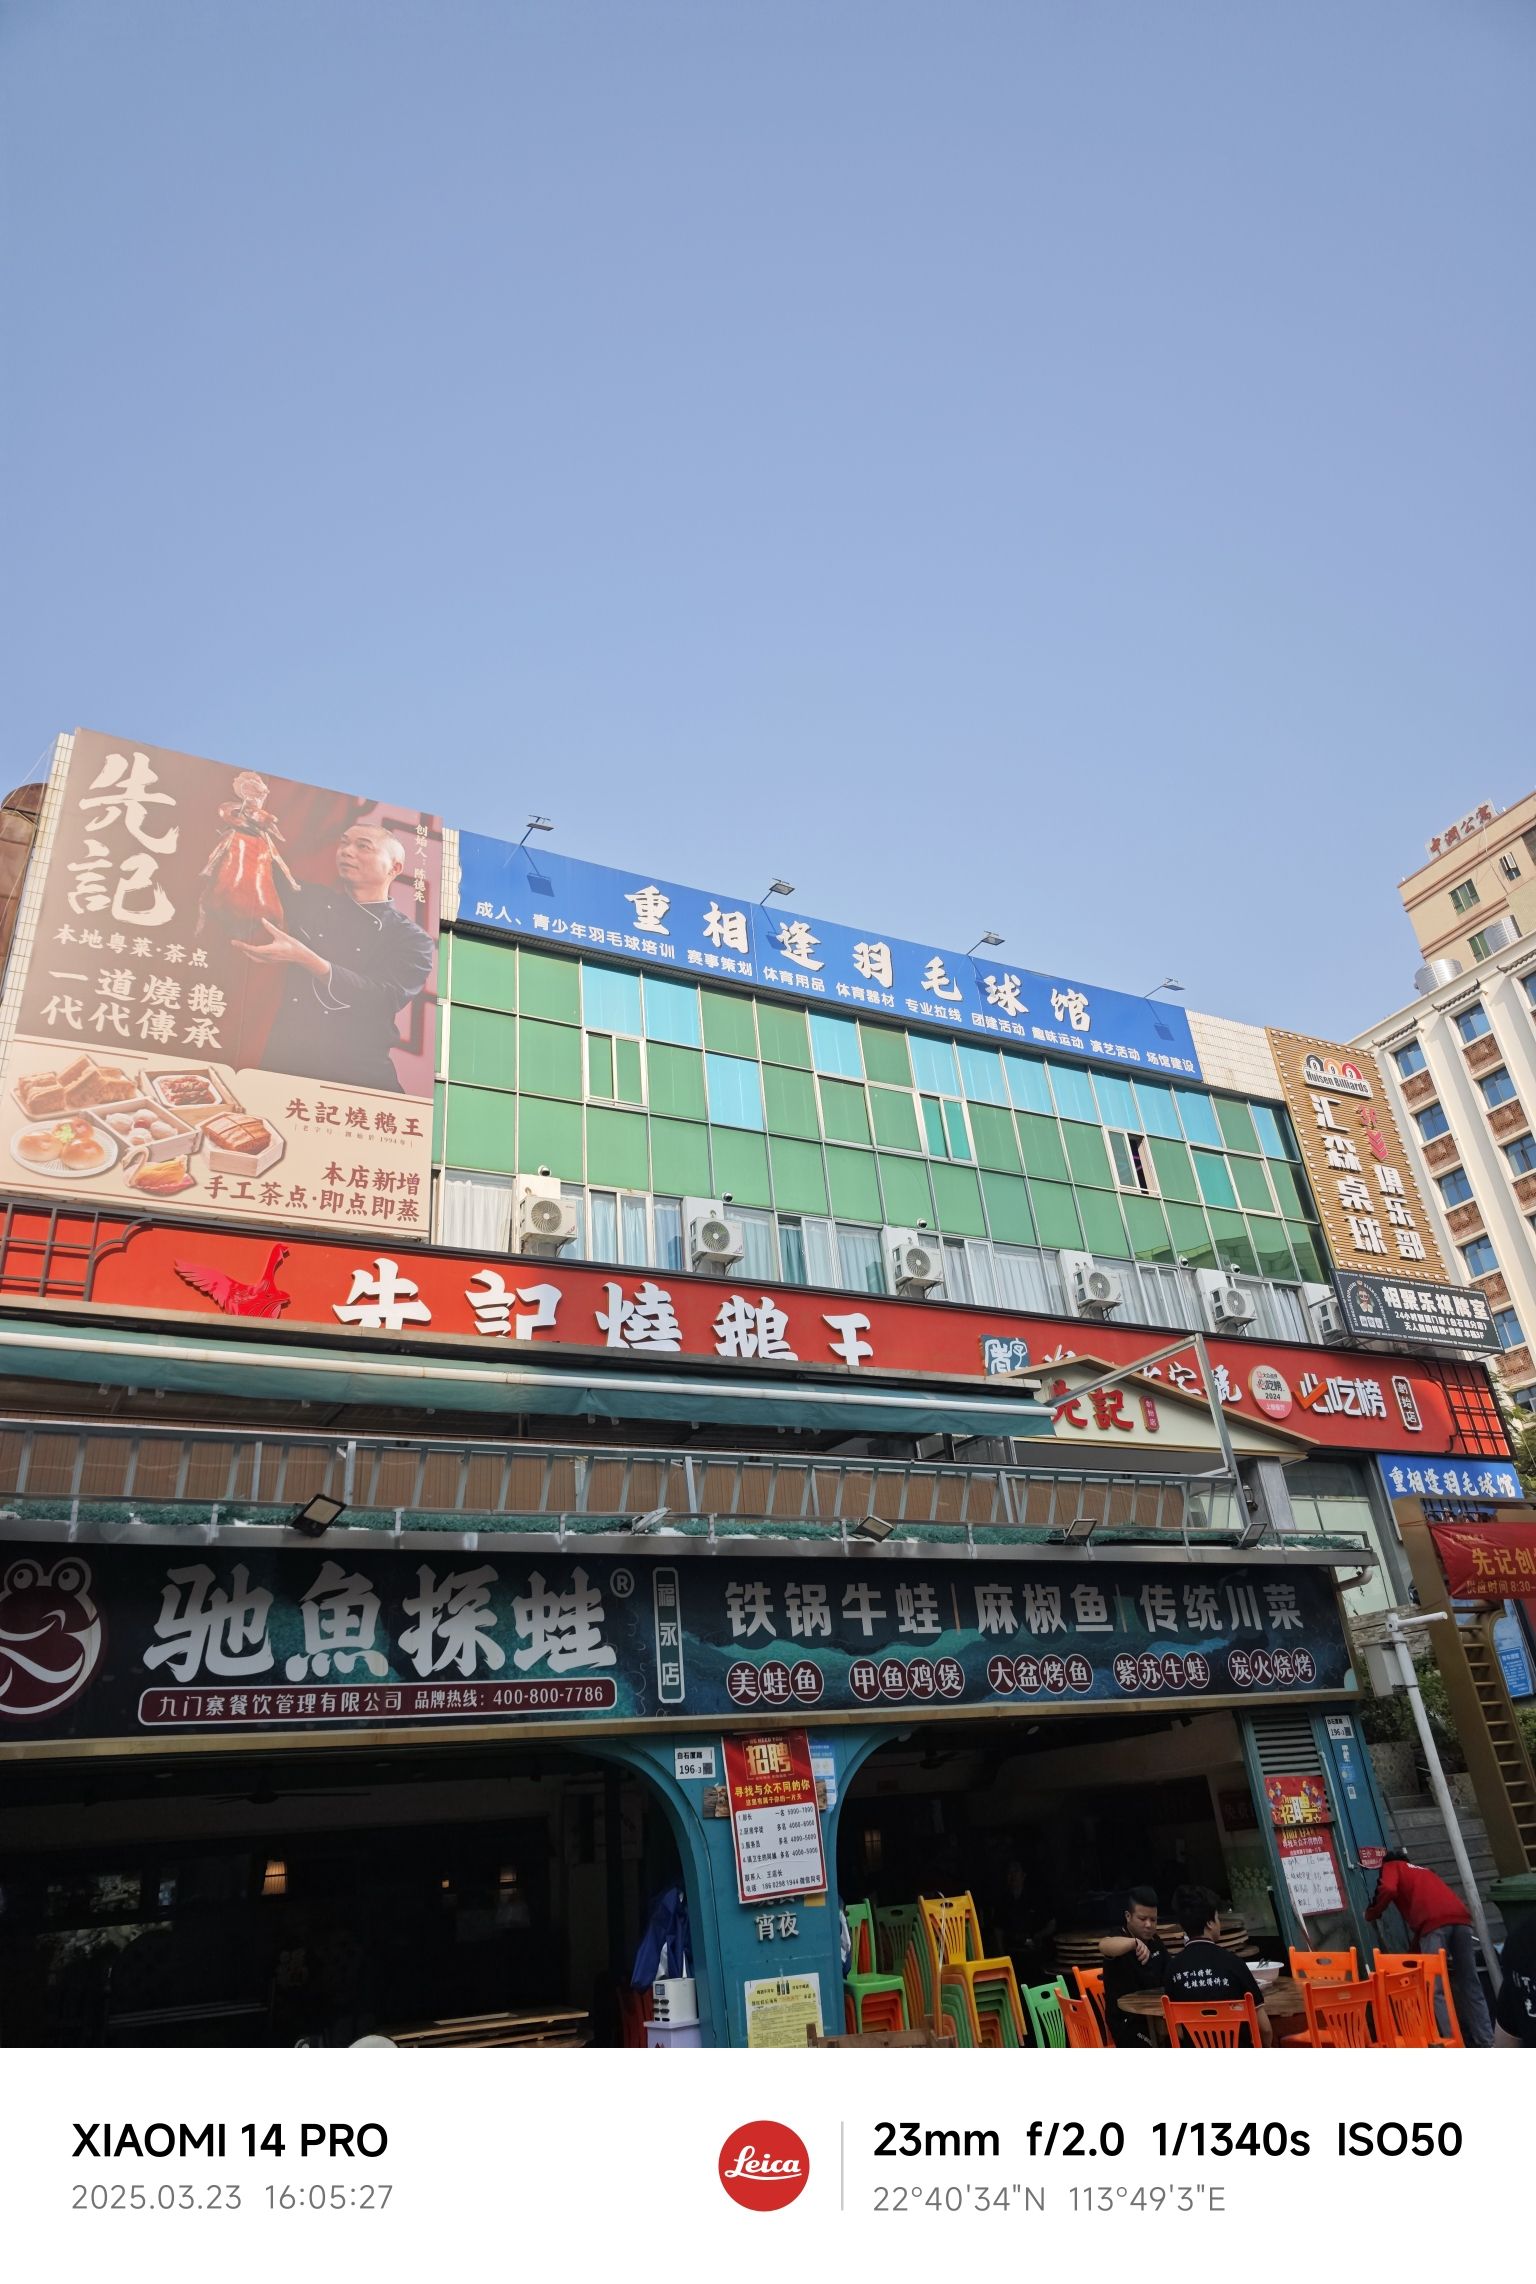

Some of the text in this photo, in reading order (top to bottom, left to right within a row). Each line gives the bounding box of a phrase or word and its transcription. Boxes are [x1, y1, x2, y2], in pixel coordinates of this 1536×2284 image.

[67, 752, 179, 926] 先記
[53, 924, 209, 969] 本地粤菜·茶点
[624, 884, 1091, 1032] 重相逢羽毛球馆
[48, 967, 227, 1018] 一道燒鵝
[475, 901, 1195, 1074] 成人、青少年羽毛球培训 赛事策划 体育用品 体育器材 专业拉线 团建活动 趣味运动 演艺活动 场馆建设
[41, 995, 222, 1048] 代代傳承
[1334, 1077, 1368, 1093] Billiards
[285, 1097, 423, 1138] 先記燒鵝王
[321, 1161, 420, 1196] 本店新增
[1309, 1093, 1388, 1254] 汇森桌球
[203, 1175, 420, 1223] 手工茶点·即点即蒸
[1373, 1164, 1426, 1260] 俱乐部
[1265, 1392, 1281, 1400] 2024
[1297, 1372, 1387, 1418] 必吃榜
[1389, 1466, 1516, 1498] 重相逢羽毛球馆
[1471, 1547, 1536, 1576] 先记创
[725, 1581, 1305, 1639] 铁锅牛蛙 麻椒鱼 传统川菜
[657, 1581, 680, 1688] 福永店
[730, 1652, 1316, 1703] 美蛙鱼 甲鱼鸡煲 大盆烤鱼 紫苏牛蛙 炭火烧烤
[157, 1690, 402, 1720] 九门寨餐饮管理有限公司
[493, 1685, 604, 1708] 400-800-7786
[746, 1742, 791, 1776] 招聘
[735, 1778, 811, 1798] 寻找与众不同的你
[755, 1911, 800, 1941] 宵夜
